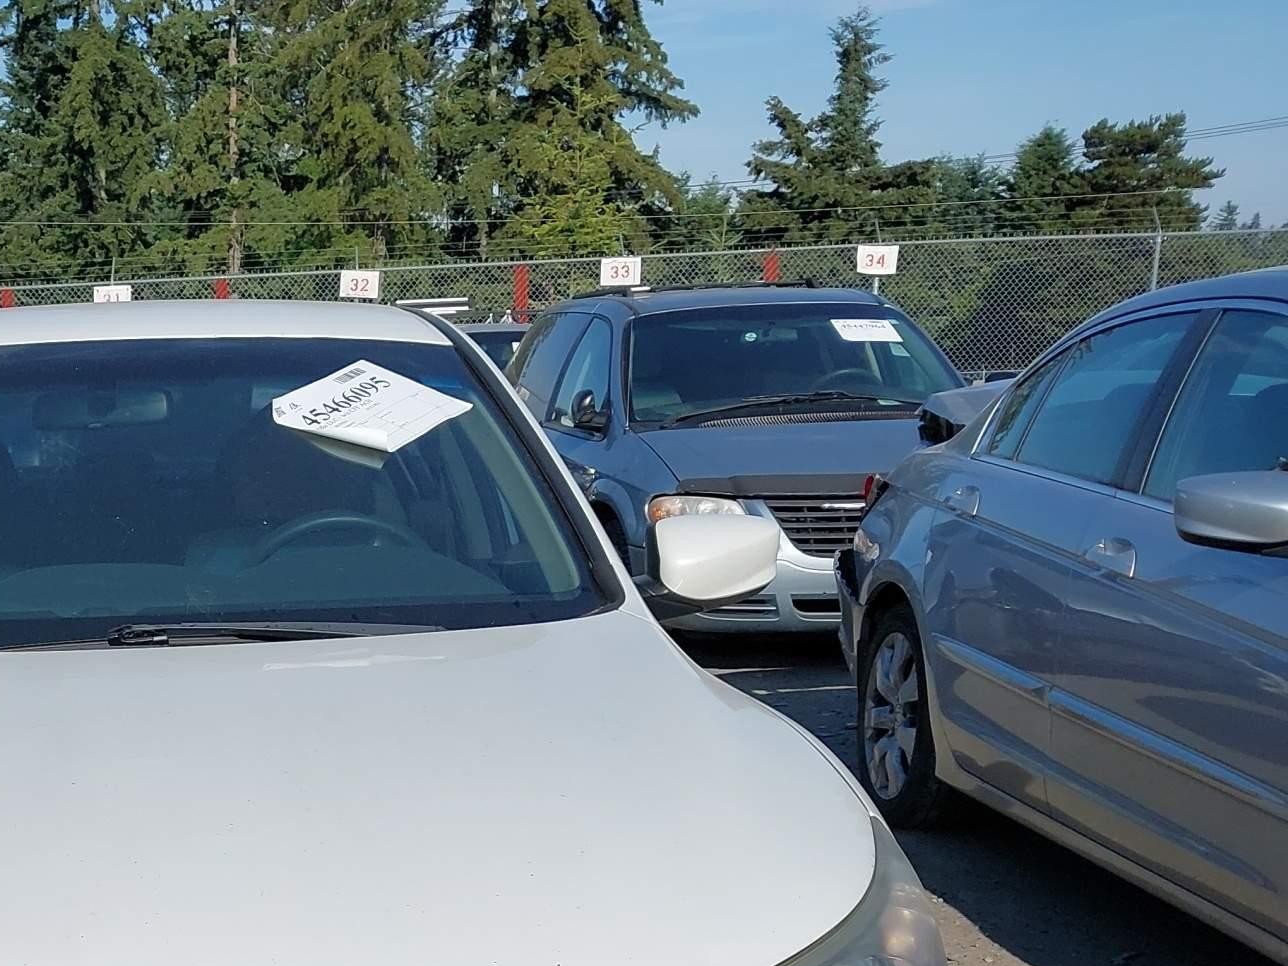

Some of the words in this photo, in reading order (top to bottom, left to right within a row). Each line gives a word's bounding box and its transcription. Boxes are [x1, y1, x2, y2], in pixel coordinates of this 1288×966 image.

[865, 254, 886, 268] 34
[610, 265, 630, 280] 33
[350, 278, 370, 292] 32
[301, 376, 392, 428] 45466095
